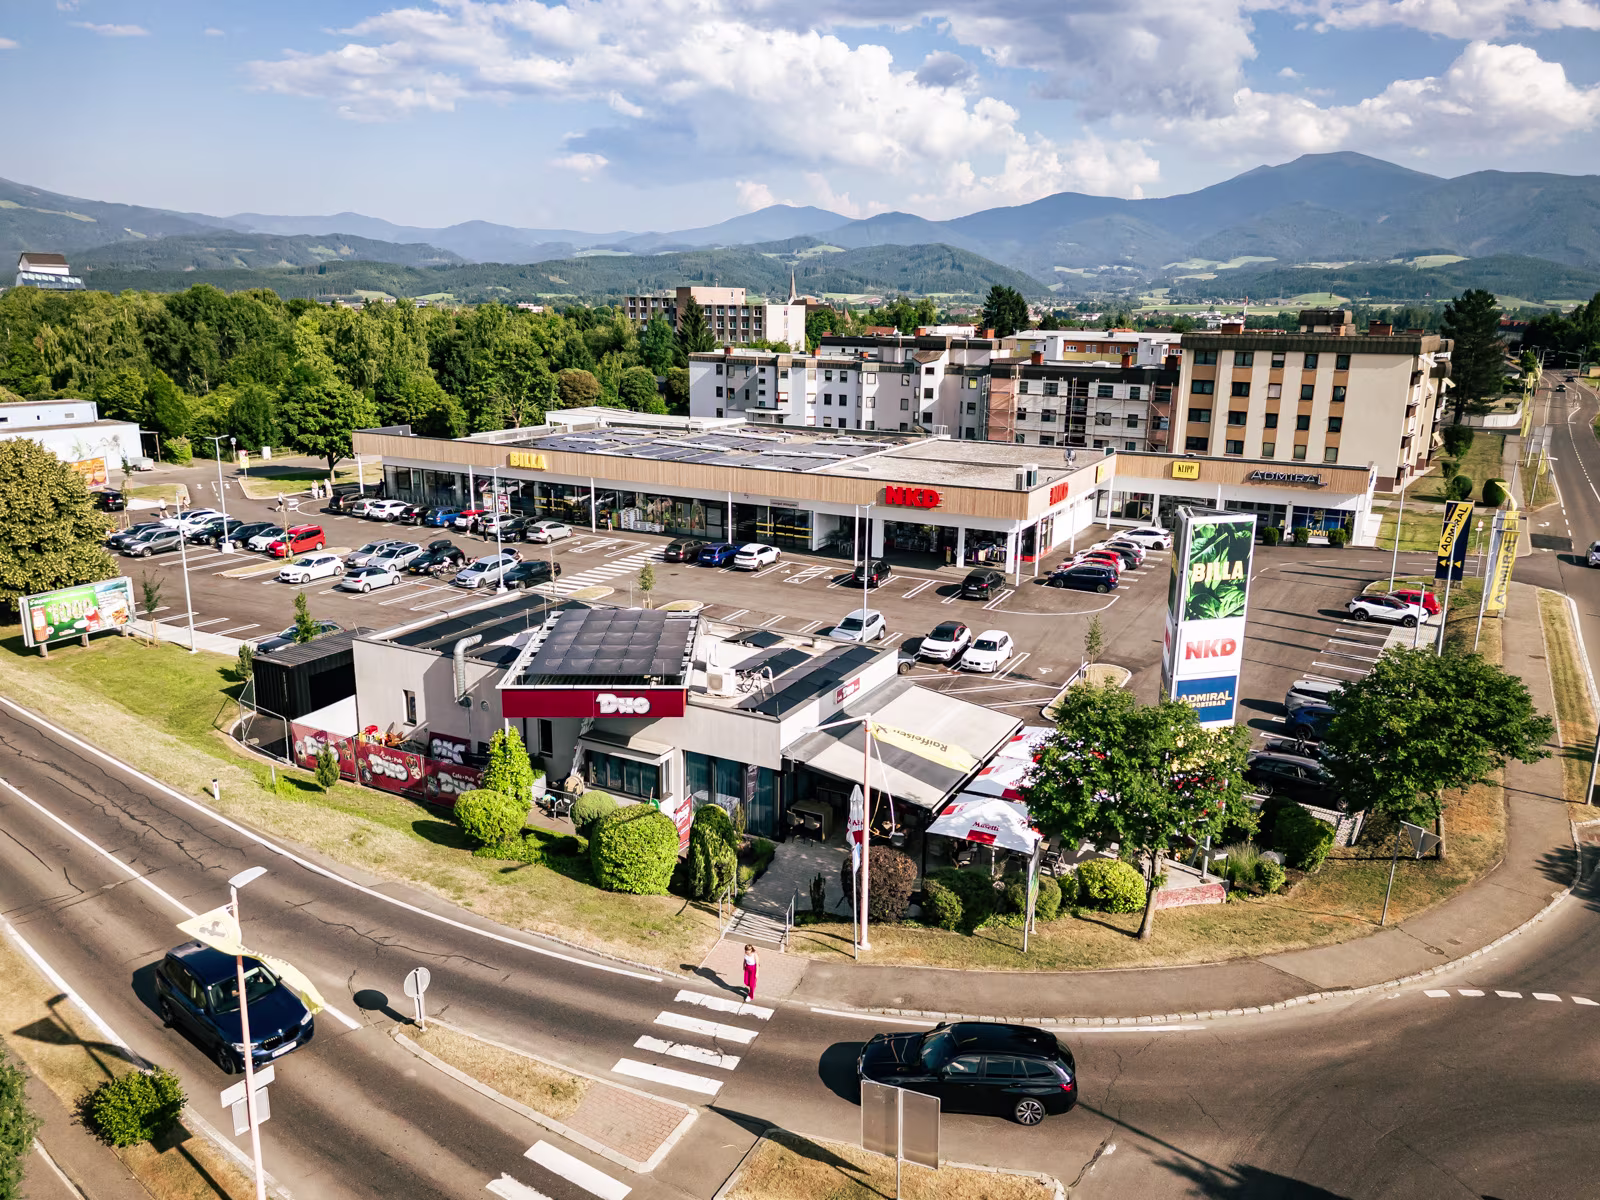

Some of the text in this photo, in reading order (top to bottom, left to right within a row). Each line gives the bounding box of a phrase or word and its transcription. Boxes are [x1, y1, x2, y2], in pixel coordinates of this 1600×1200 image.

[509, 451, 548, 470] BILLA
[1250, 469, 1328, 487] ADMIRAL
[885, 485, 941, 509] NKD
[1050, 482, 1069, 506] NKD
[1191, 560, 1244, 583] BILLA
[1184, 637, 1237, 660] NKD
[1178, 690, 1233, 704] ADMIRAL
[1190, 700, 1227, 708] PORTSBAR
